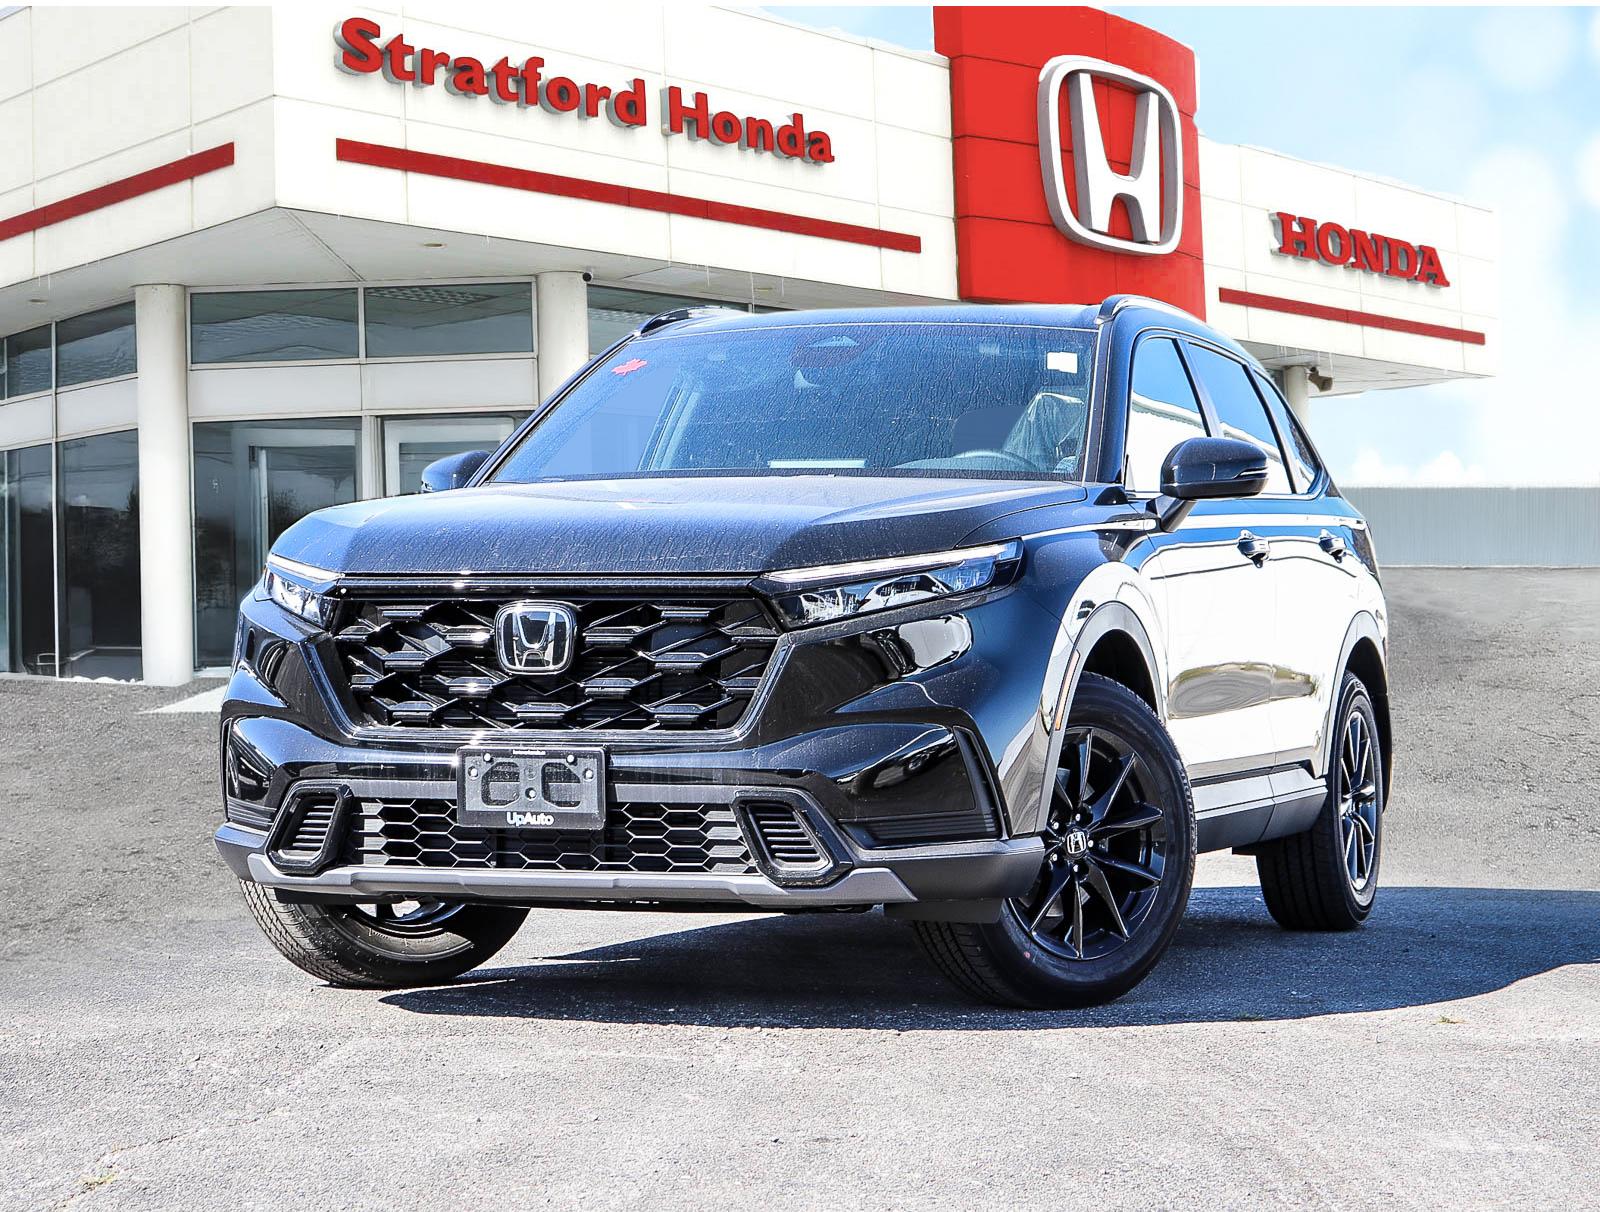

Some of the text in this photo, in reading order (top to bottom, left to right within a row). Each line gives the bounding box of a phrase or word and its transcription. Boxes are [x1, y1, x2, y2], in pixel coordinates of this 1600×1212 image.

[337, 17, 835, 164] Stratford Honda
[1273, 211, 1450, 287] HONDA
[506, 811, 555, 827] UpAuto
